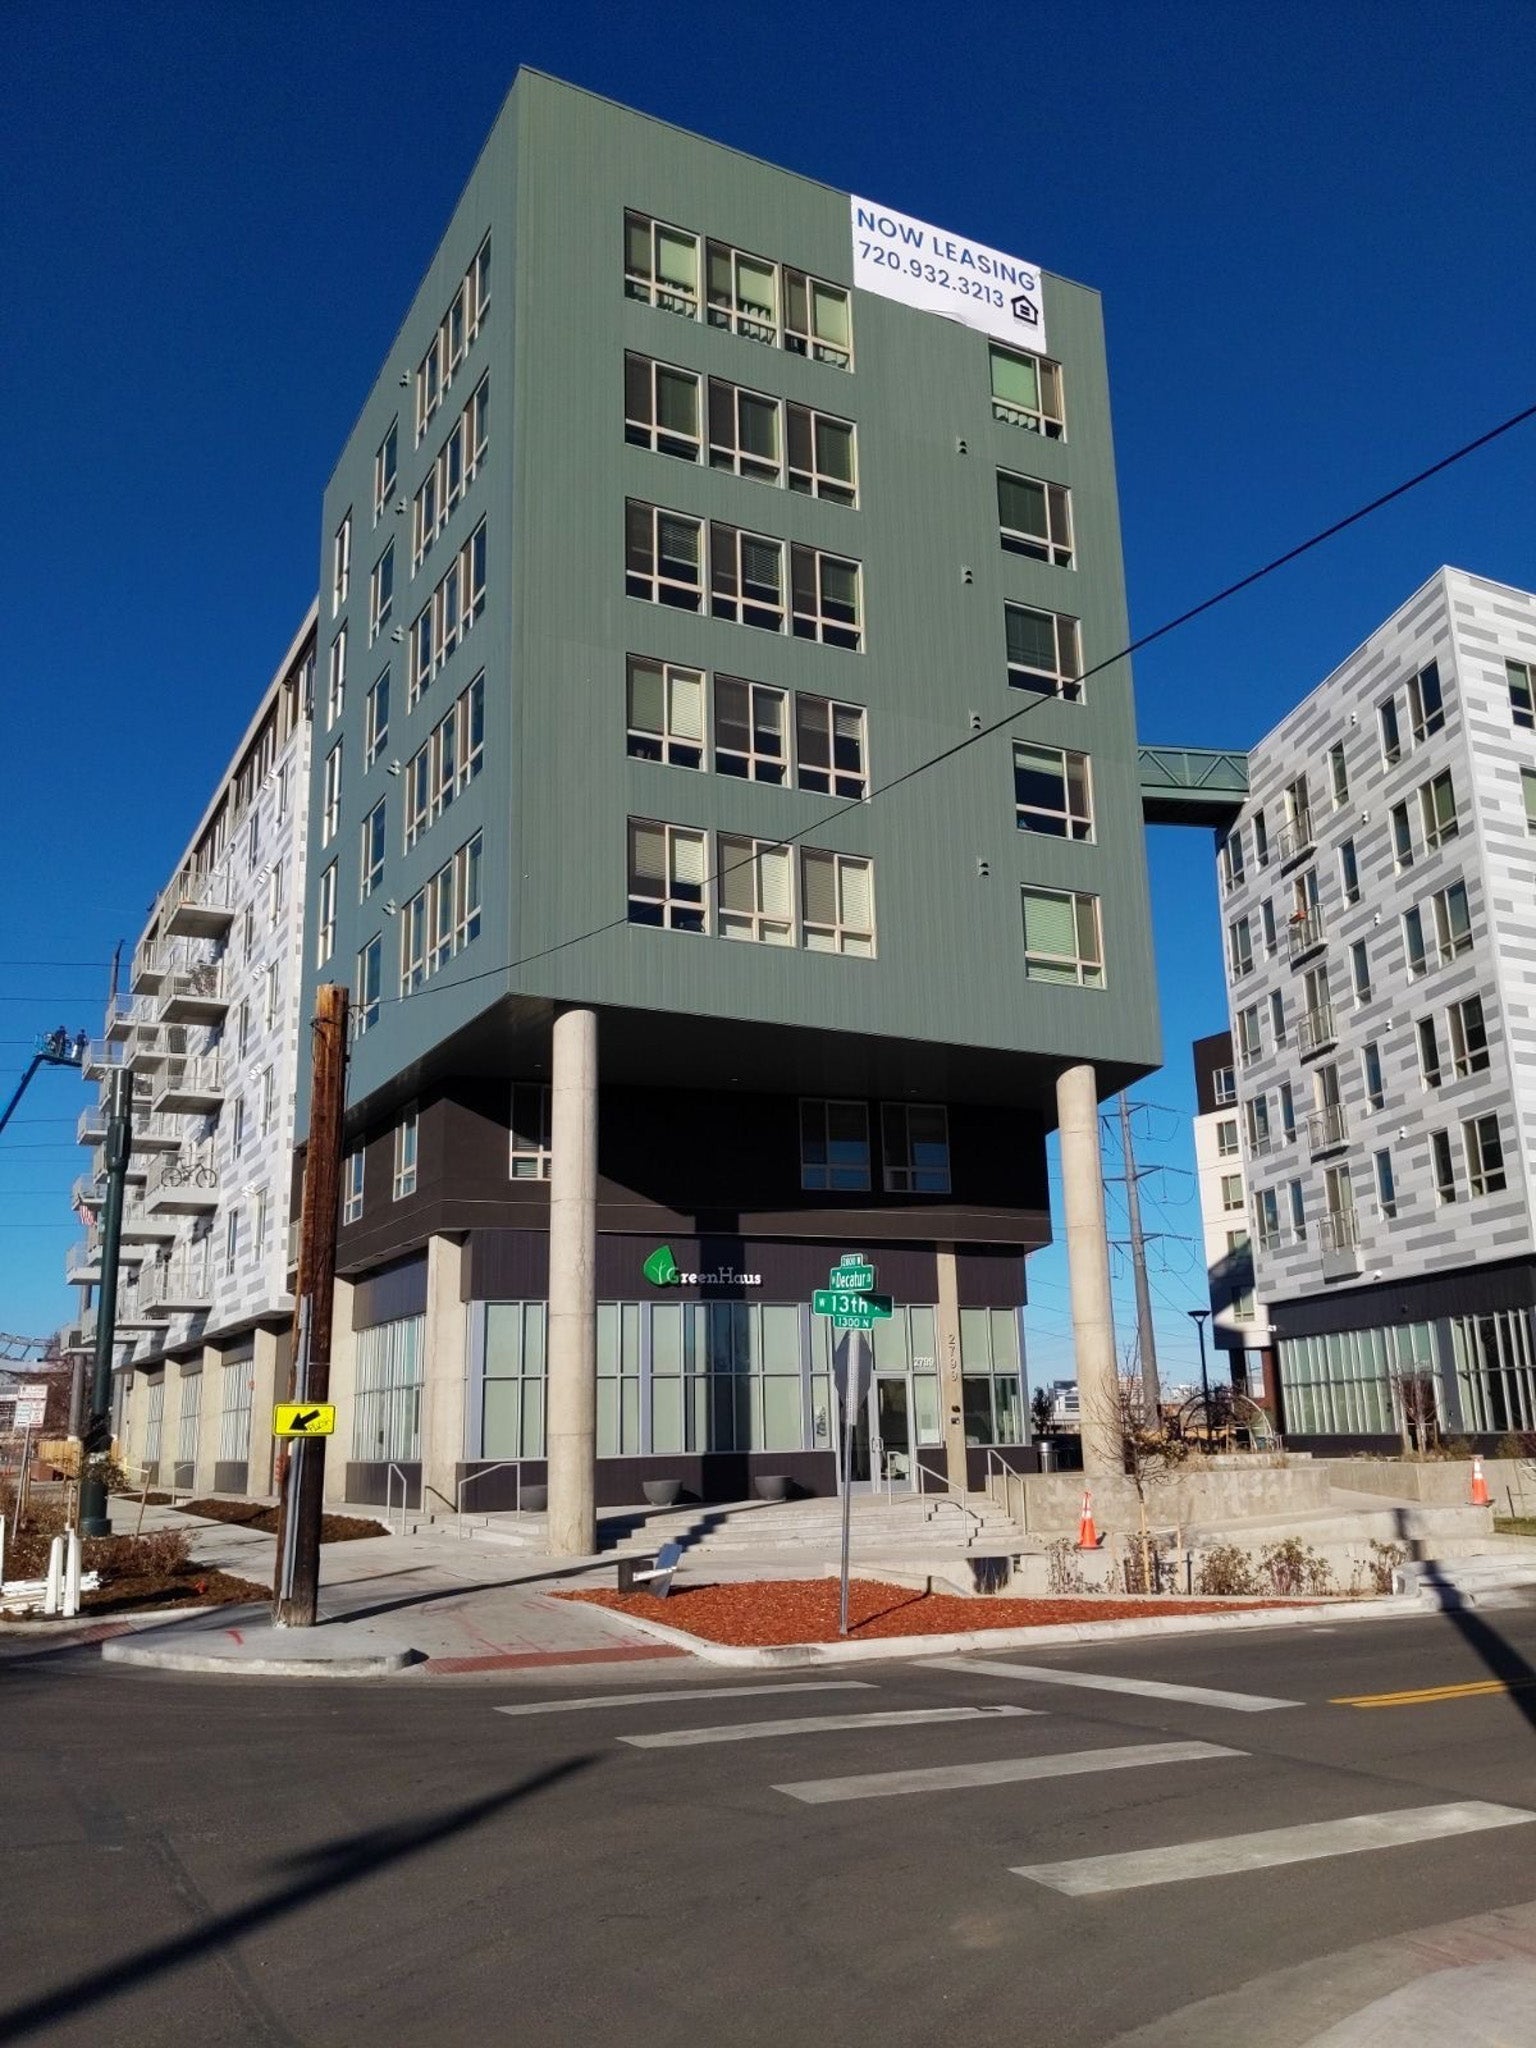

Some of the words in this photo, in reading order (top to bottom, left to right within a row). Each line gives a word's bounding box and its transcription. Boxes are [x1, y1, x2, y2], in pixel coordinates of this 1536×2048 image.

[857, 208, 923, 248] NOW
[933, 237, 1035, 291] LEASING
[859, 240, 1004, 308] 720.932.3213
[666, 1267, 761, 1284] GreenHaus
[836, 1270, 866, 1288] Decatur
[831, 1295, 868, 1314] 13th
[838, 1317, 860, 1327] 1300
[862, 1319, 869, 1328] N
[913, 1357, 934, 1367] 2799
